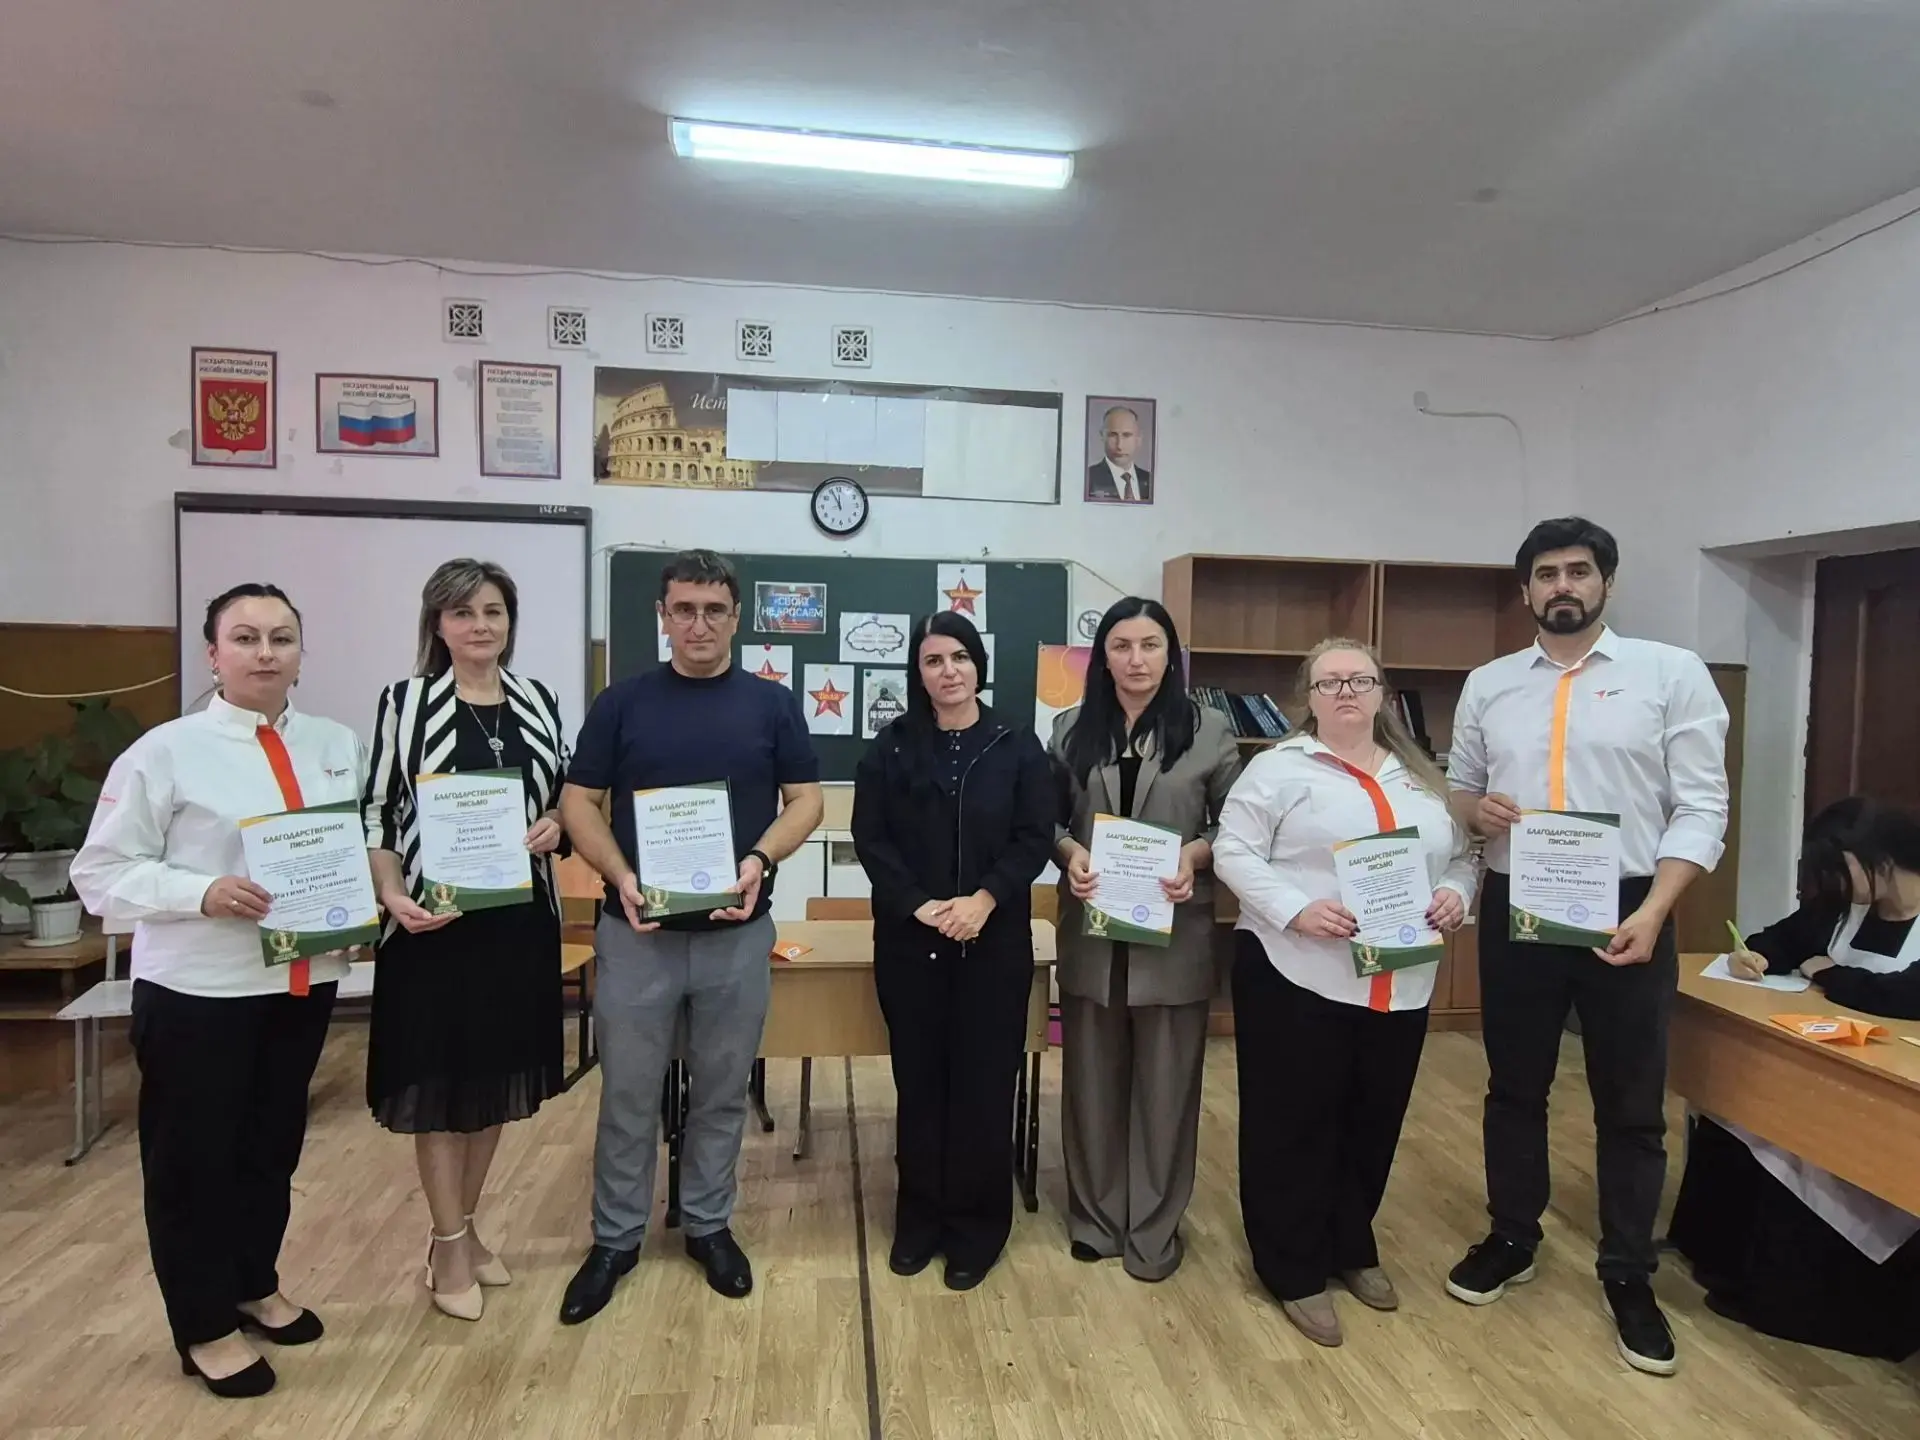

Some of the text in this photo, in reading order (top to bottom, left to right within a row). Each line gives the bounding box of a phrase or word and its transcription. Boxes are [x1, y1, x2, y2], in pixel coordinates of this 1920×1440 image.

[690, 393, 726, 410] Ист
[434, 787, 509, 801] БЛАГОДАРСТВЕННОЕ
[456, 799, 488, 808] ПИСЬМО
[649, 798, 716, 812] БЛАГОДАРСТВЕННОЕ
[669, 809, 698, 818] ПИСЬМО
[262, 822, 345, 845] БЛАГОДАРСТВЕННОЕ
[1106, 832, 1168, 846] БЛАГОДАРСТВЕННОЕ
[1527, 827, 1604, 839] БЛАГОДАРСТВЕННОЕ
[289, 836, 324, 850] ПИСЬМО
[1122, 843, 1149, 852] ПИСЬМО
[1548, 838, 1580, 847] ПИСЬМО
[1348, 847, 1409, 867] БЛАГОДАРСТВЕННОЕ
[1367, 860, 1393, 872] ПИСЬМО
[308, 875, 358, 893] Руслановне
[1520, 873, 1553, 884] Руслану
[1384, 899, 1414, 913] Юрьевне
